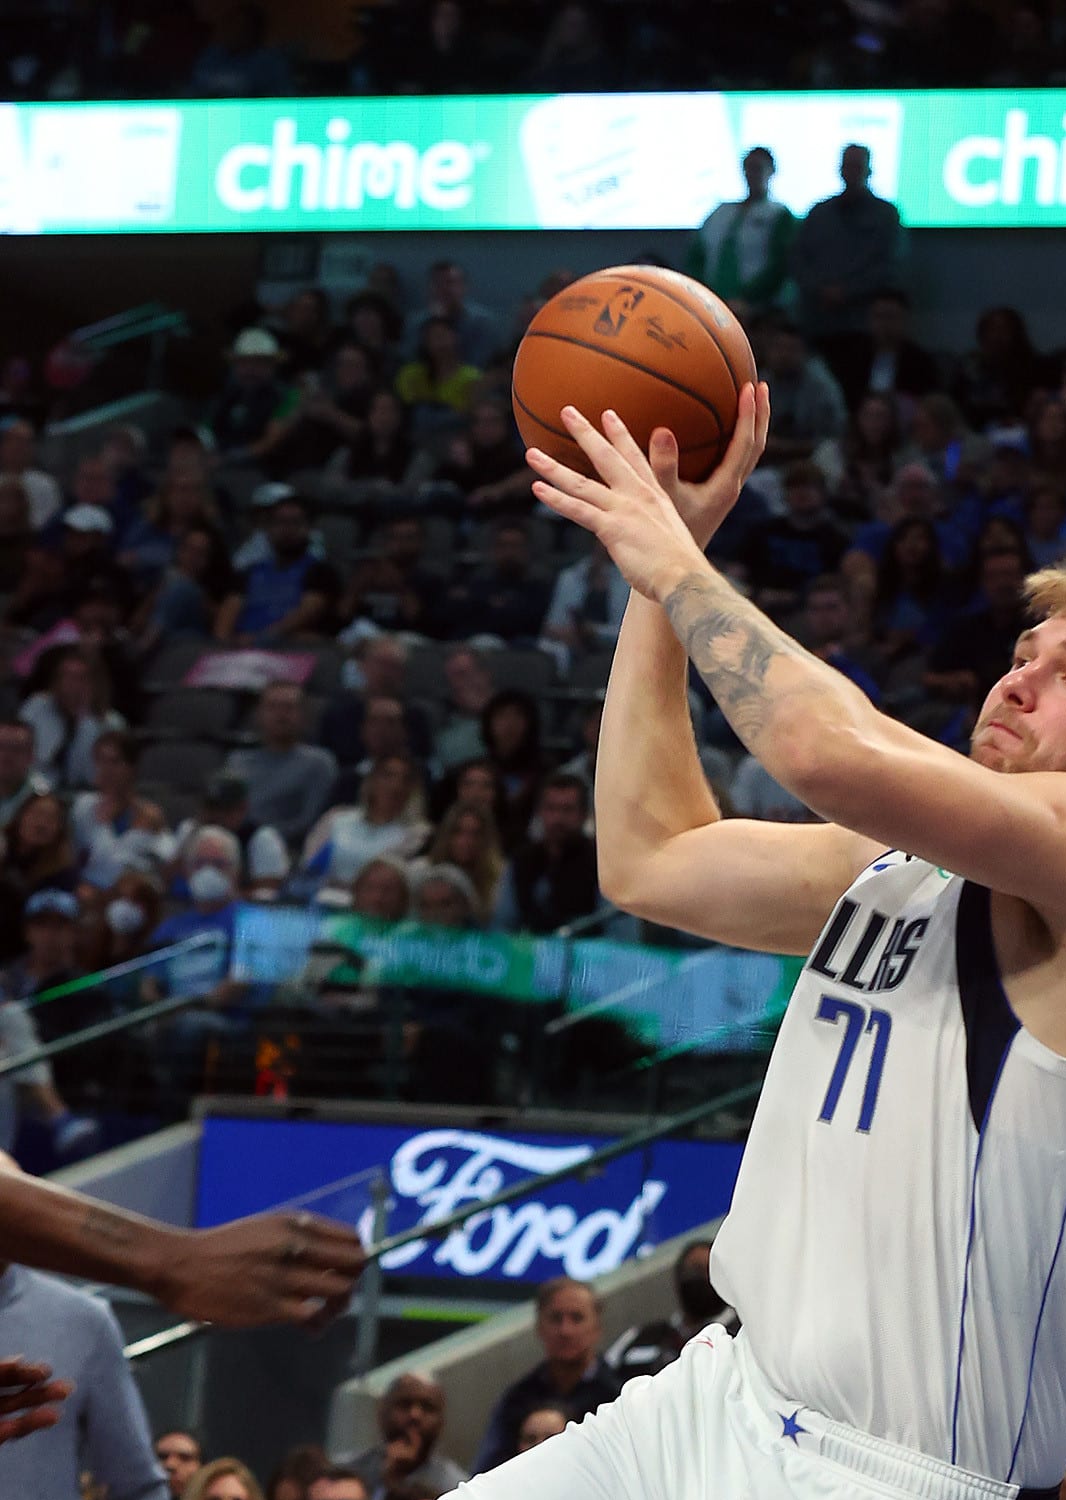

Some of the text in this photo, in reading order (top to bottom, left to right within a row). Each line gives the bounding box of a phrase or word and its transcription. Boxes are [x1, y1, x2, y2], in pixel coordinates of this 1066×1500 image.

[216, 118, 474, 211] chime
[809, 899, 931, 992] LLAS
[357, 1129, 667, 1281] Ford
